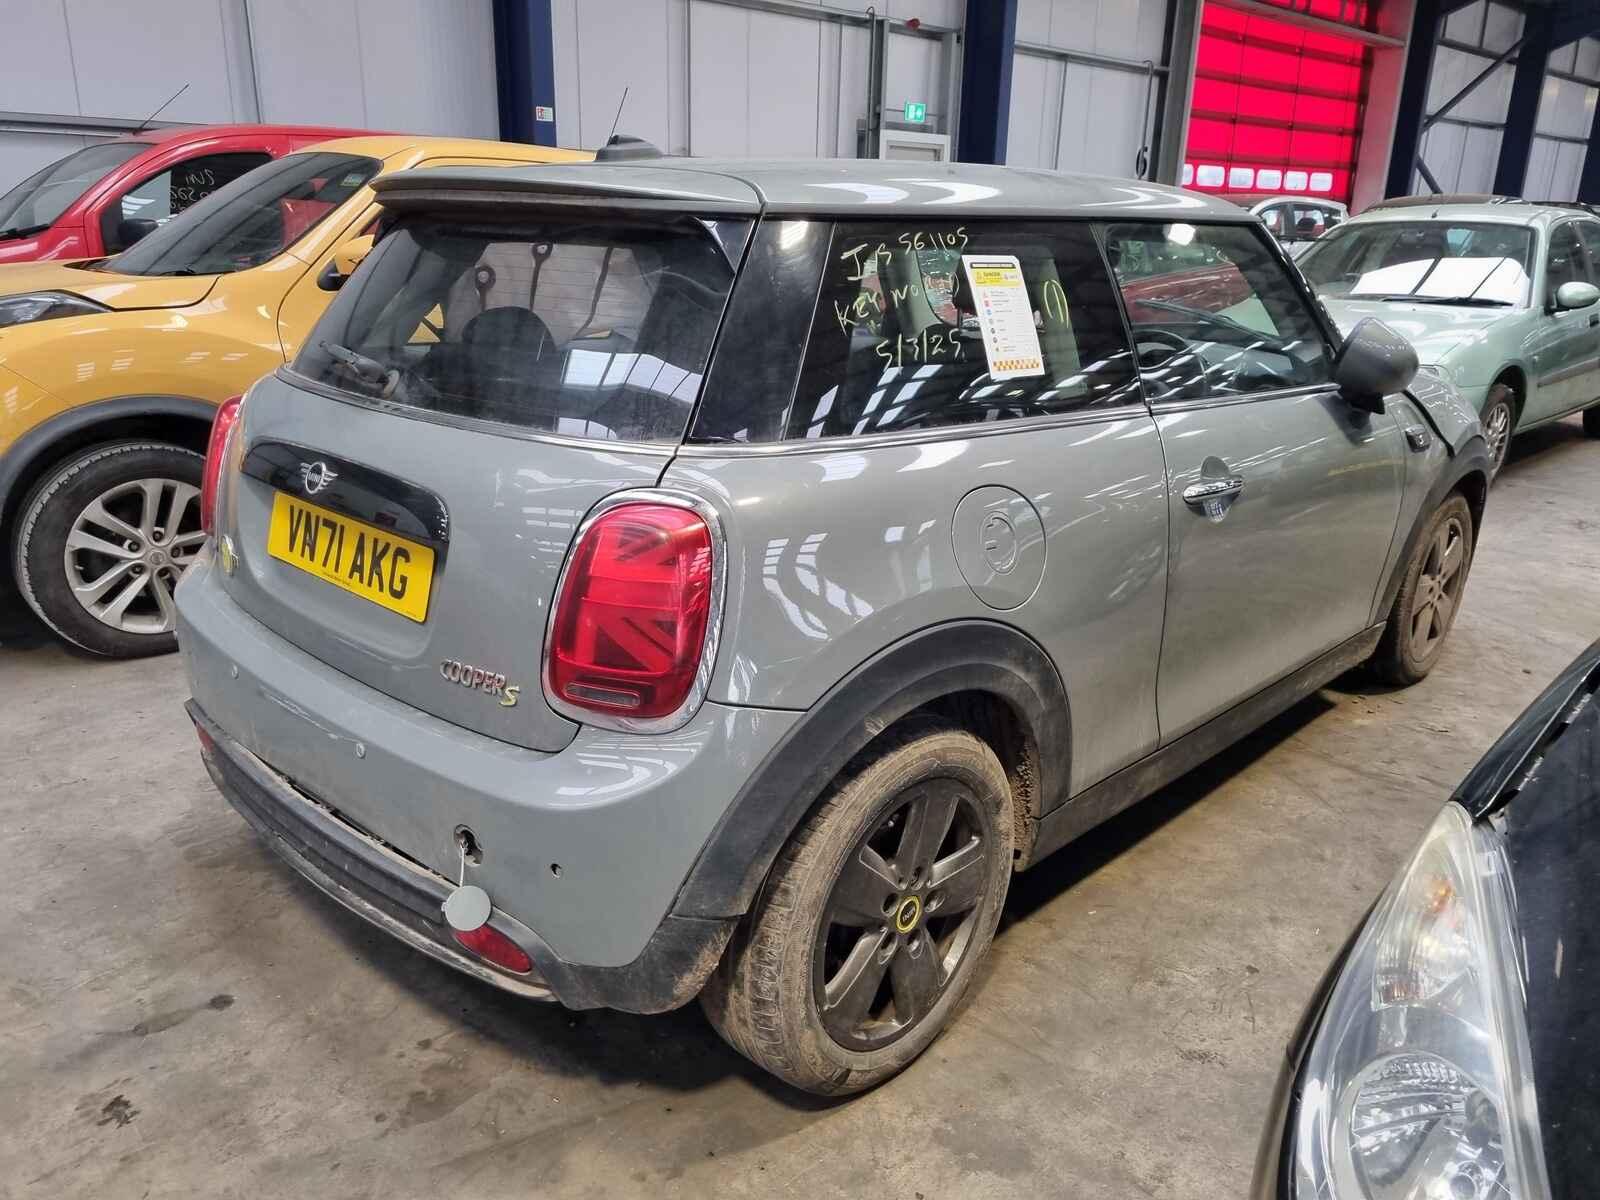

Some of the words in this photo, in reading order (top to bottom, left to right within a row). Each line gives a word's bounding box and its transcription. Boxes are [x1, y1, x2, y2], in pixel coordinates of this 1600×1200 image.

[899, 227, 969, 257] 561105
[288, 504, 345, 574] VN71
[348, 532, 411, 600] AKG
[440, 659, 506, 696] COOPER
[500, 686, 521, 706] S
